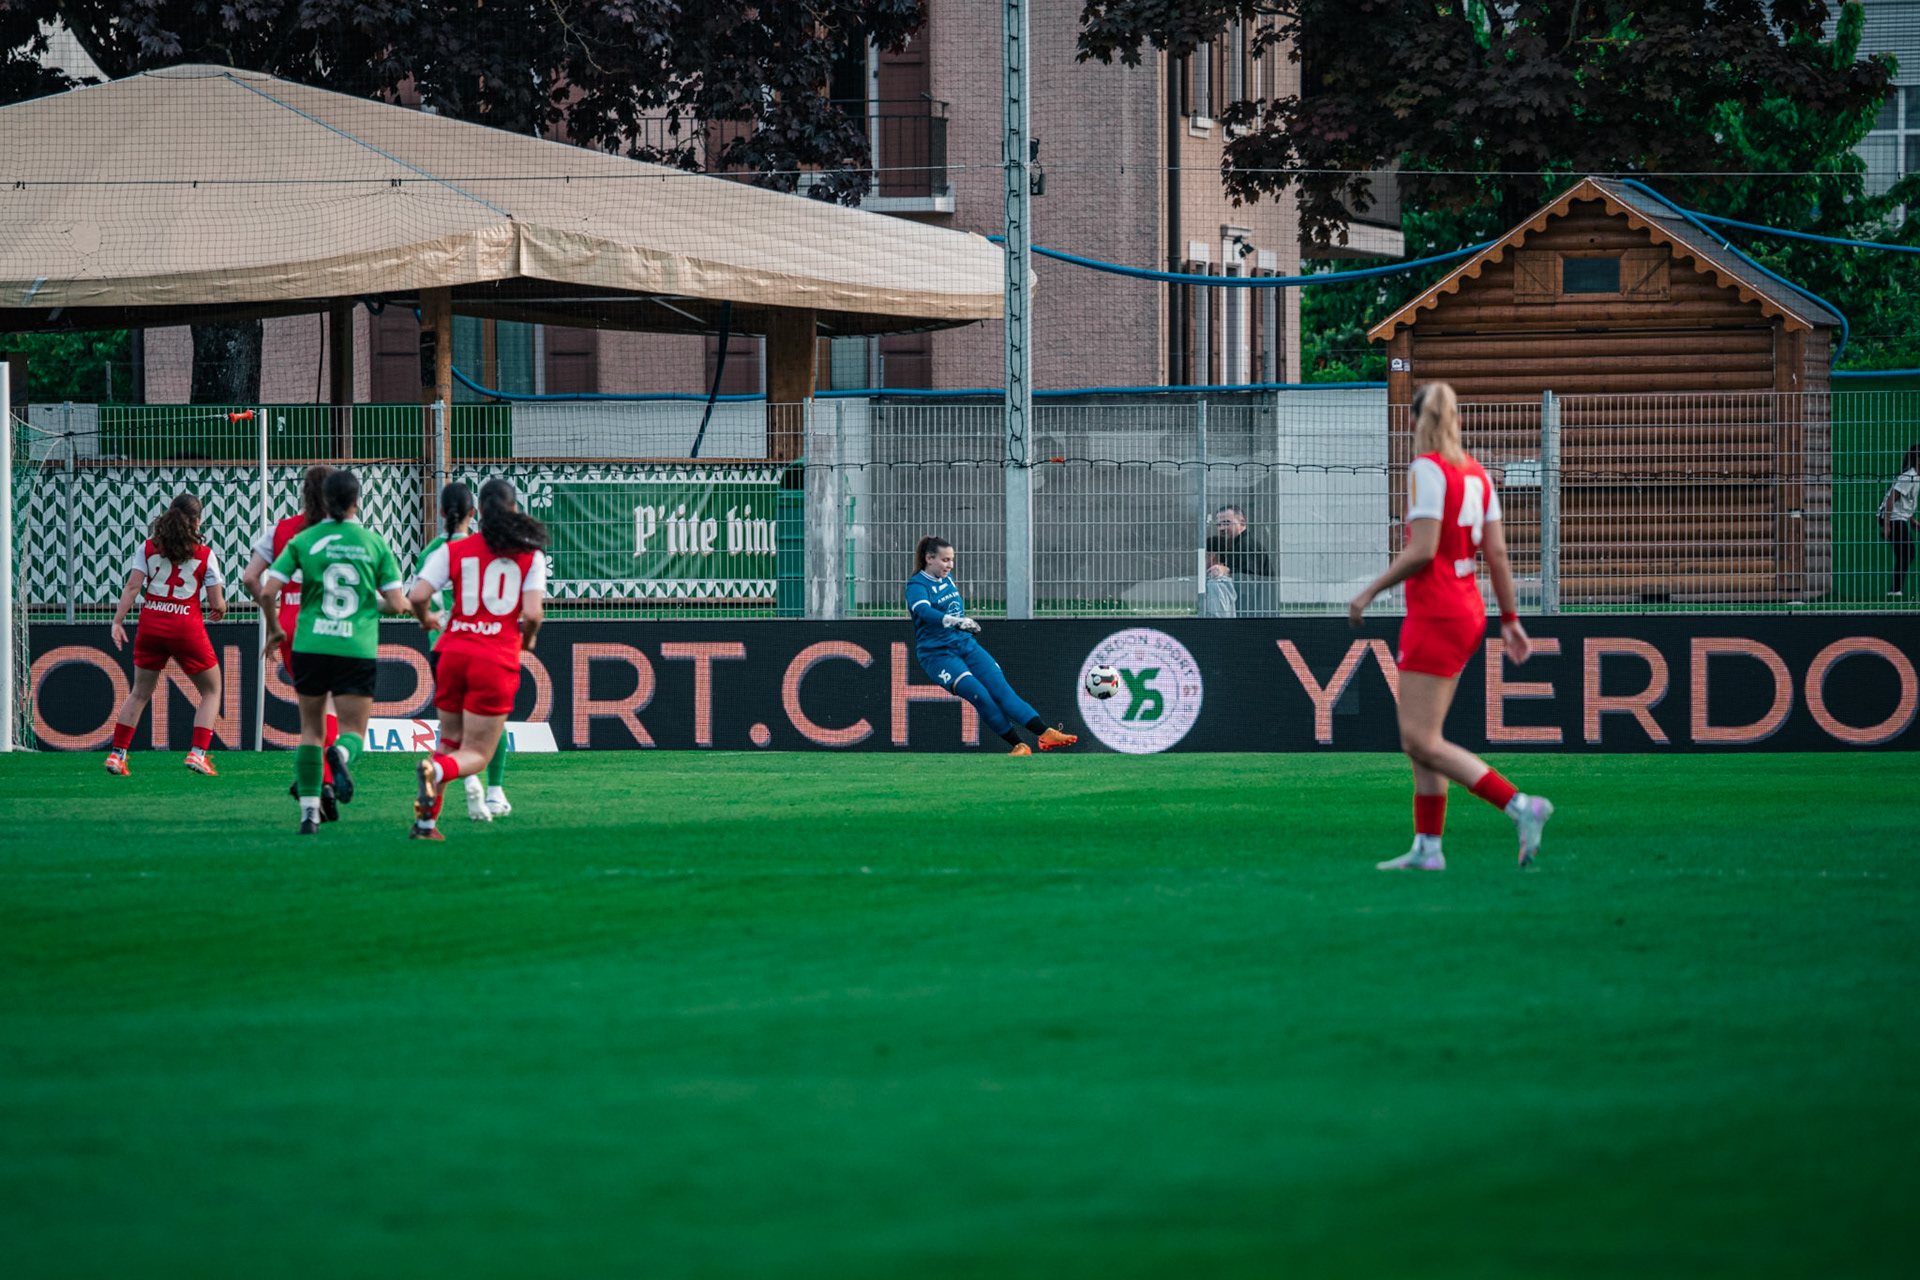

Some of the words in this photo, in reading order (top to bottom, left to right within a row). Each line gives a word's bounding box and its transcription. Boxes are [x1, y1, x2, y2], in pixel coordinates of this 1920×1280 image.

[633, 503, 718, 558] P'tite
[146, 553, 202, 600] 23
[321, 562, 361, 621] 6
[461, 556, 522, 616] 10
[144, 599, 191, 616] MARKOVIC
[368, 728, 405, 751] LA
